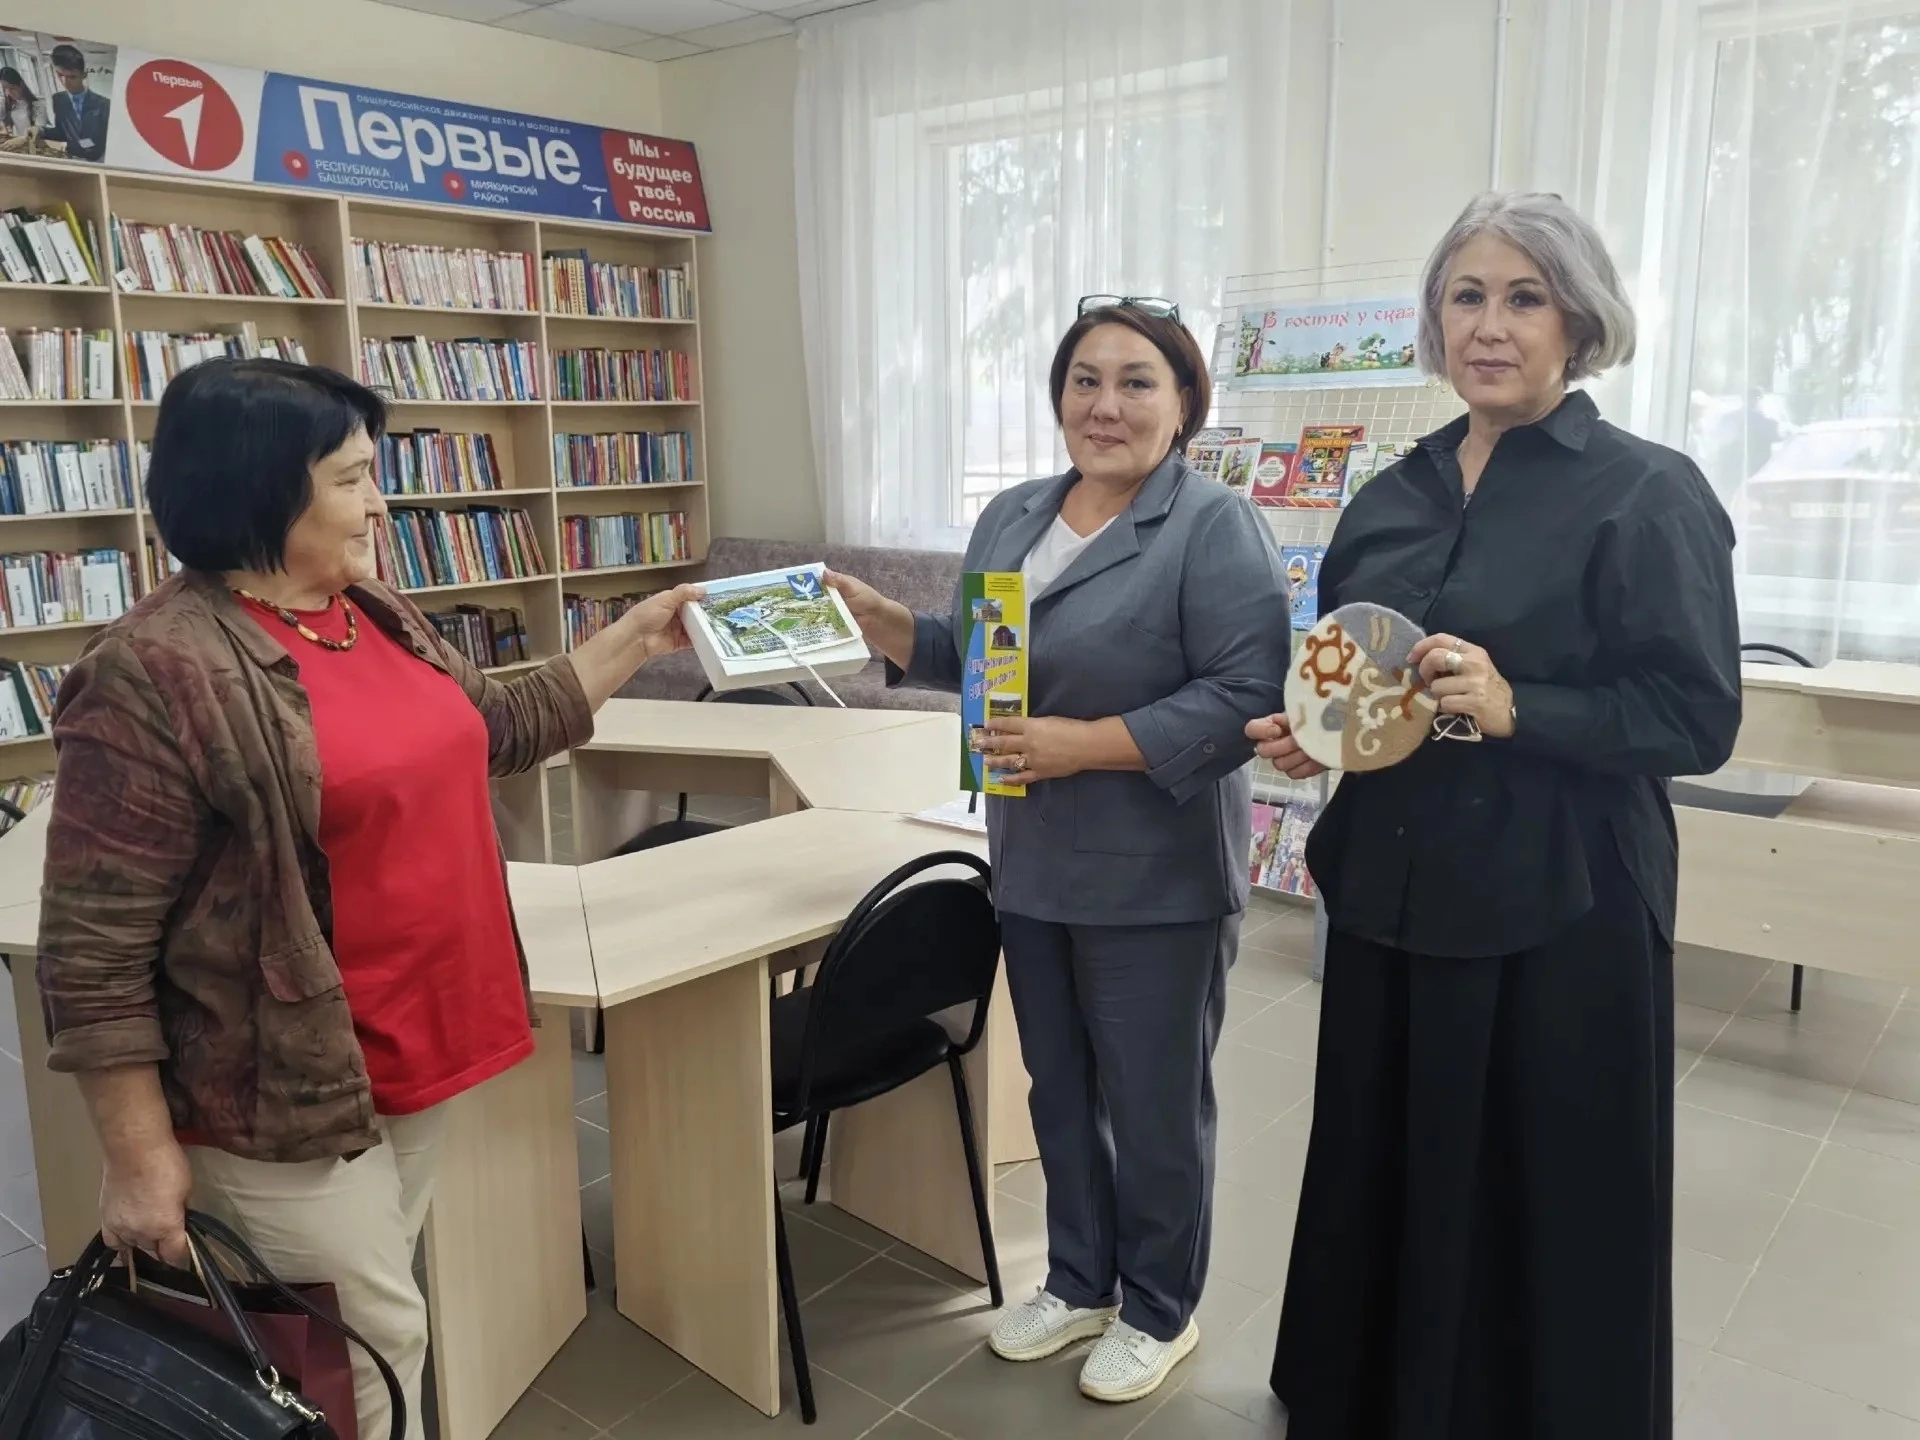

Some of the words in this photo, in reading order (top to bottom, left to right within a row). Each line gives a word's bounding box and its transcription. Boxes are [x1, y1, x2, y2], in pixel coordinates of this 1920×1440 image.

[152, 71, 204, 89] Первые
[443, 109, 489, 122] ДВИЖЕНИЕ
[519, 120, 526, 128] И
[298, 85, 582, 185] Первые
[628, 138, 660, 158] Мы
[315, 159, 391, 178] РЕСПУБЛИКА
[613, 157, 693, 184] будущее
[317, 172, 409, 192] БАШКОРТОСТАН
[470, 179, 538, 196] МИЯКИНСКИЙ
[473, 192, 509, 204] РАЙОН
[634, 184, 682, 206] твоё,
[628, 200, 696, 224] Россия
[1263, 311, 1278, 329] В
[1374, 307, 1416, 324] сказ
